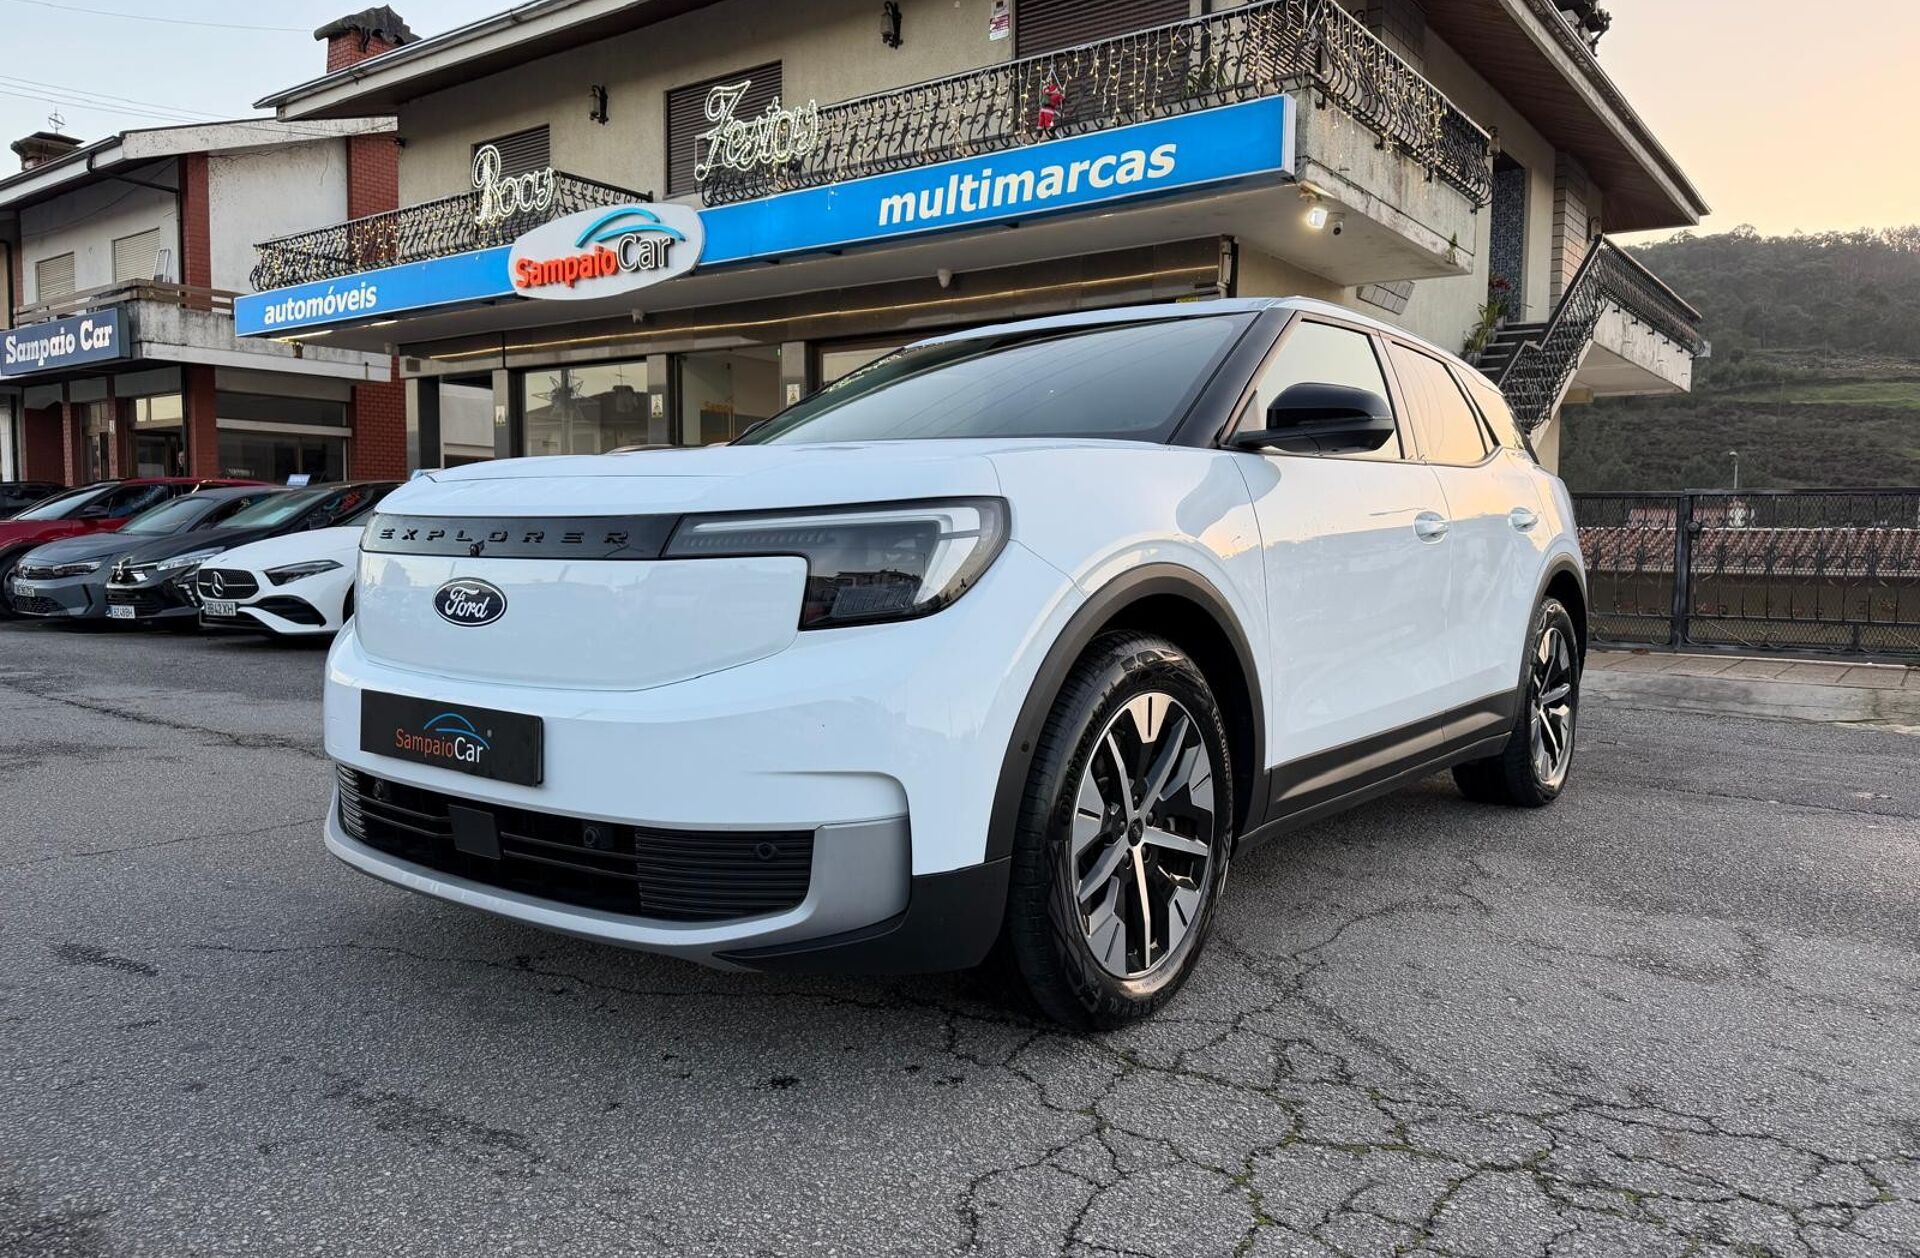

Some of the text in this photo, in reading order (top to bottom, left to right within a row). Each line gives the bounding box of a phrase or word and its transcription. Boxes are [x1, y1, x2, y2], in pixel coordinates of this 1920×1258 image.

[694, 79, 819, 181] Festas
[877, 143, 1178, 227] multimarcas
[263, 285, 378, 325] automóveis
[5, 318, 113, 366] Sampaio Car
[378, 527, 629, 546] EXPLORER
[443, 586, 489, 619] Ford
[395, 727, 484, 764] SampaioCar
